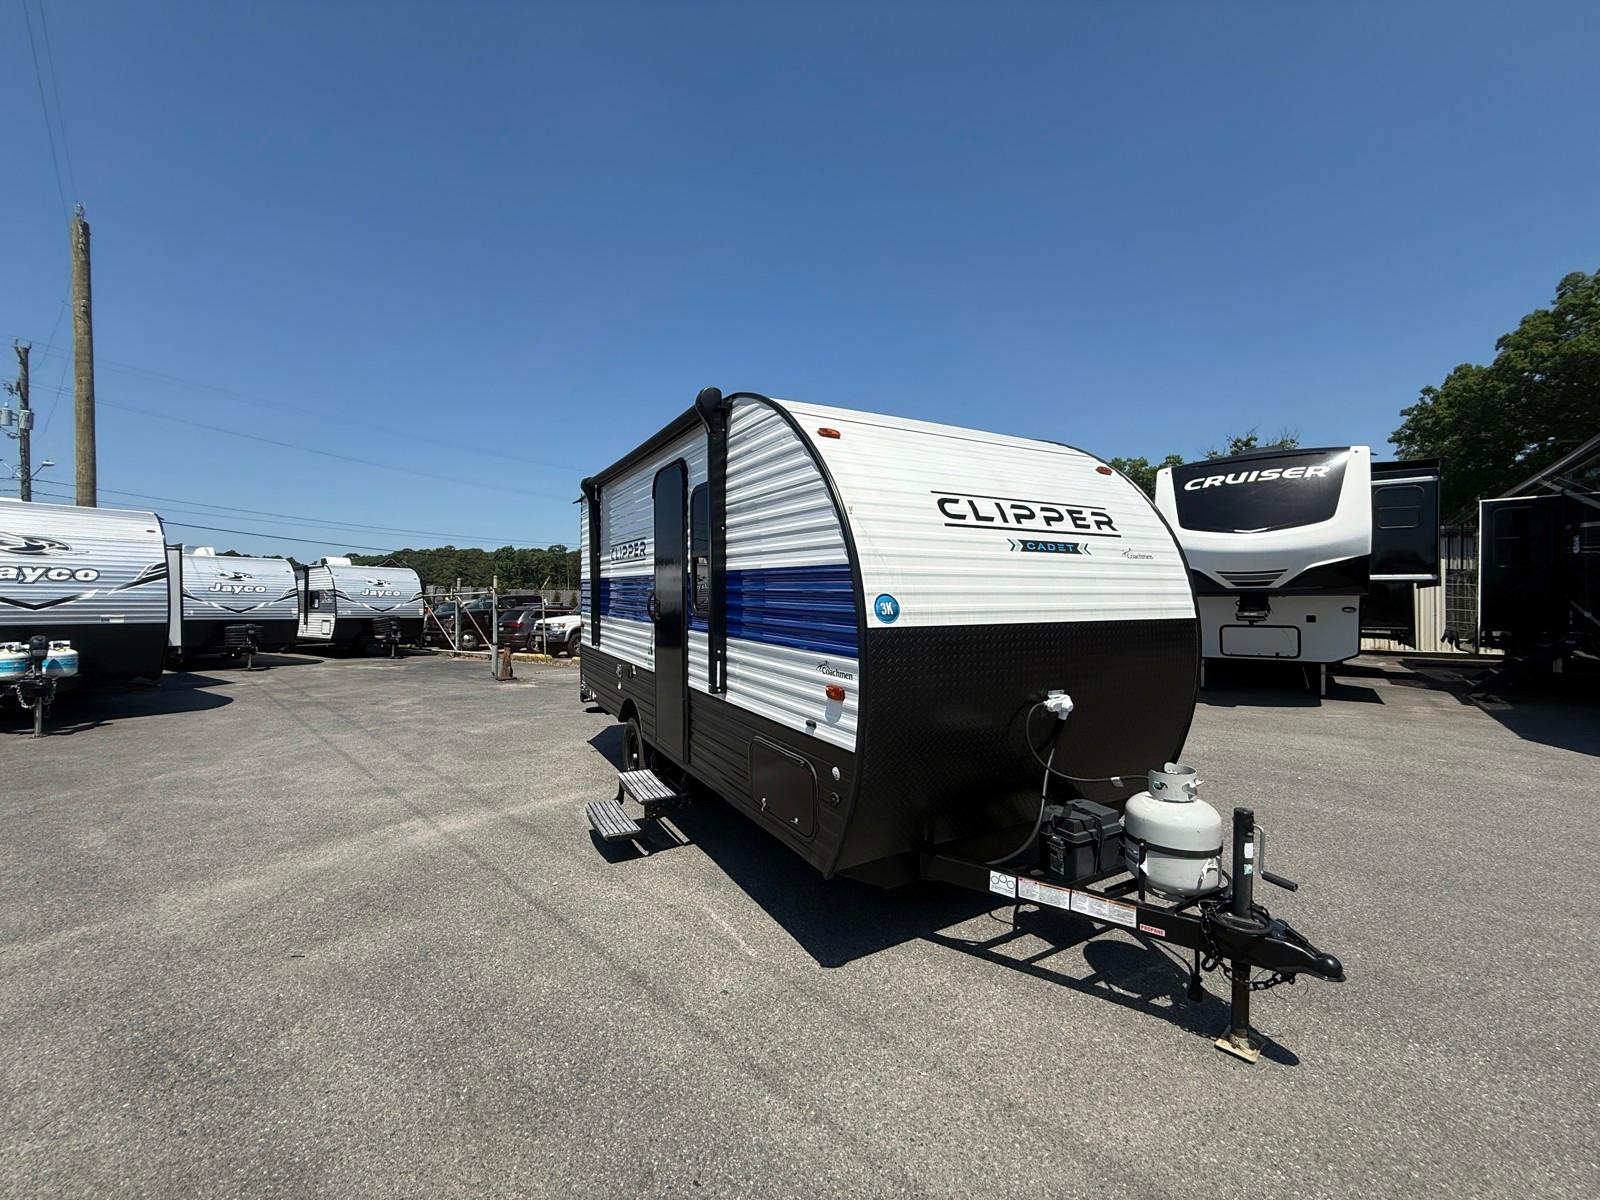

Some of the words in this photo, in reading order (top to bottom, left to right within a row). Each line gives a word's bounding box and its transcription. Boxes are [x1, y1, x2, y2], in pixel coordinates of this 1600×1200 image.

[1184, 465, 1330, 491] CRUISER
[937, 498, 1119, 531] CLIPPER
[610, 542, 647, 561] CLIPPER
[1026, 542, 1074, 552] CADET
[208, 582, 267, 594] Jayco
[361, 588, 401, 597] Jayco
[880, 602, 894, 615] 3K
[821, 666, 853, 680] Coachmen
